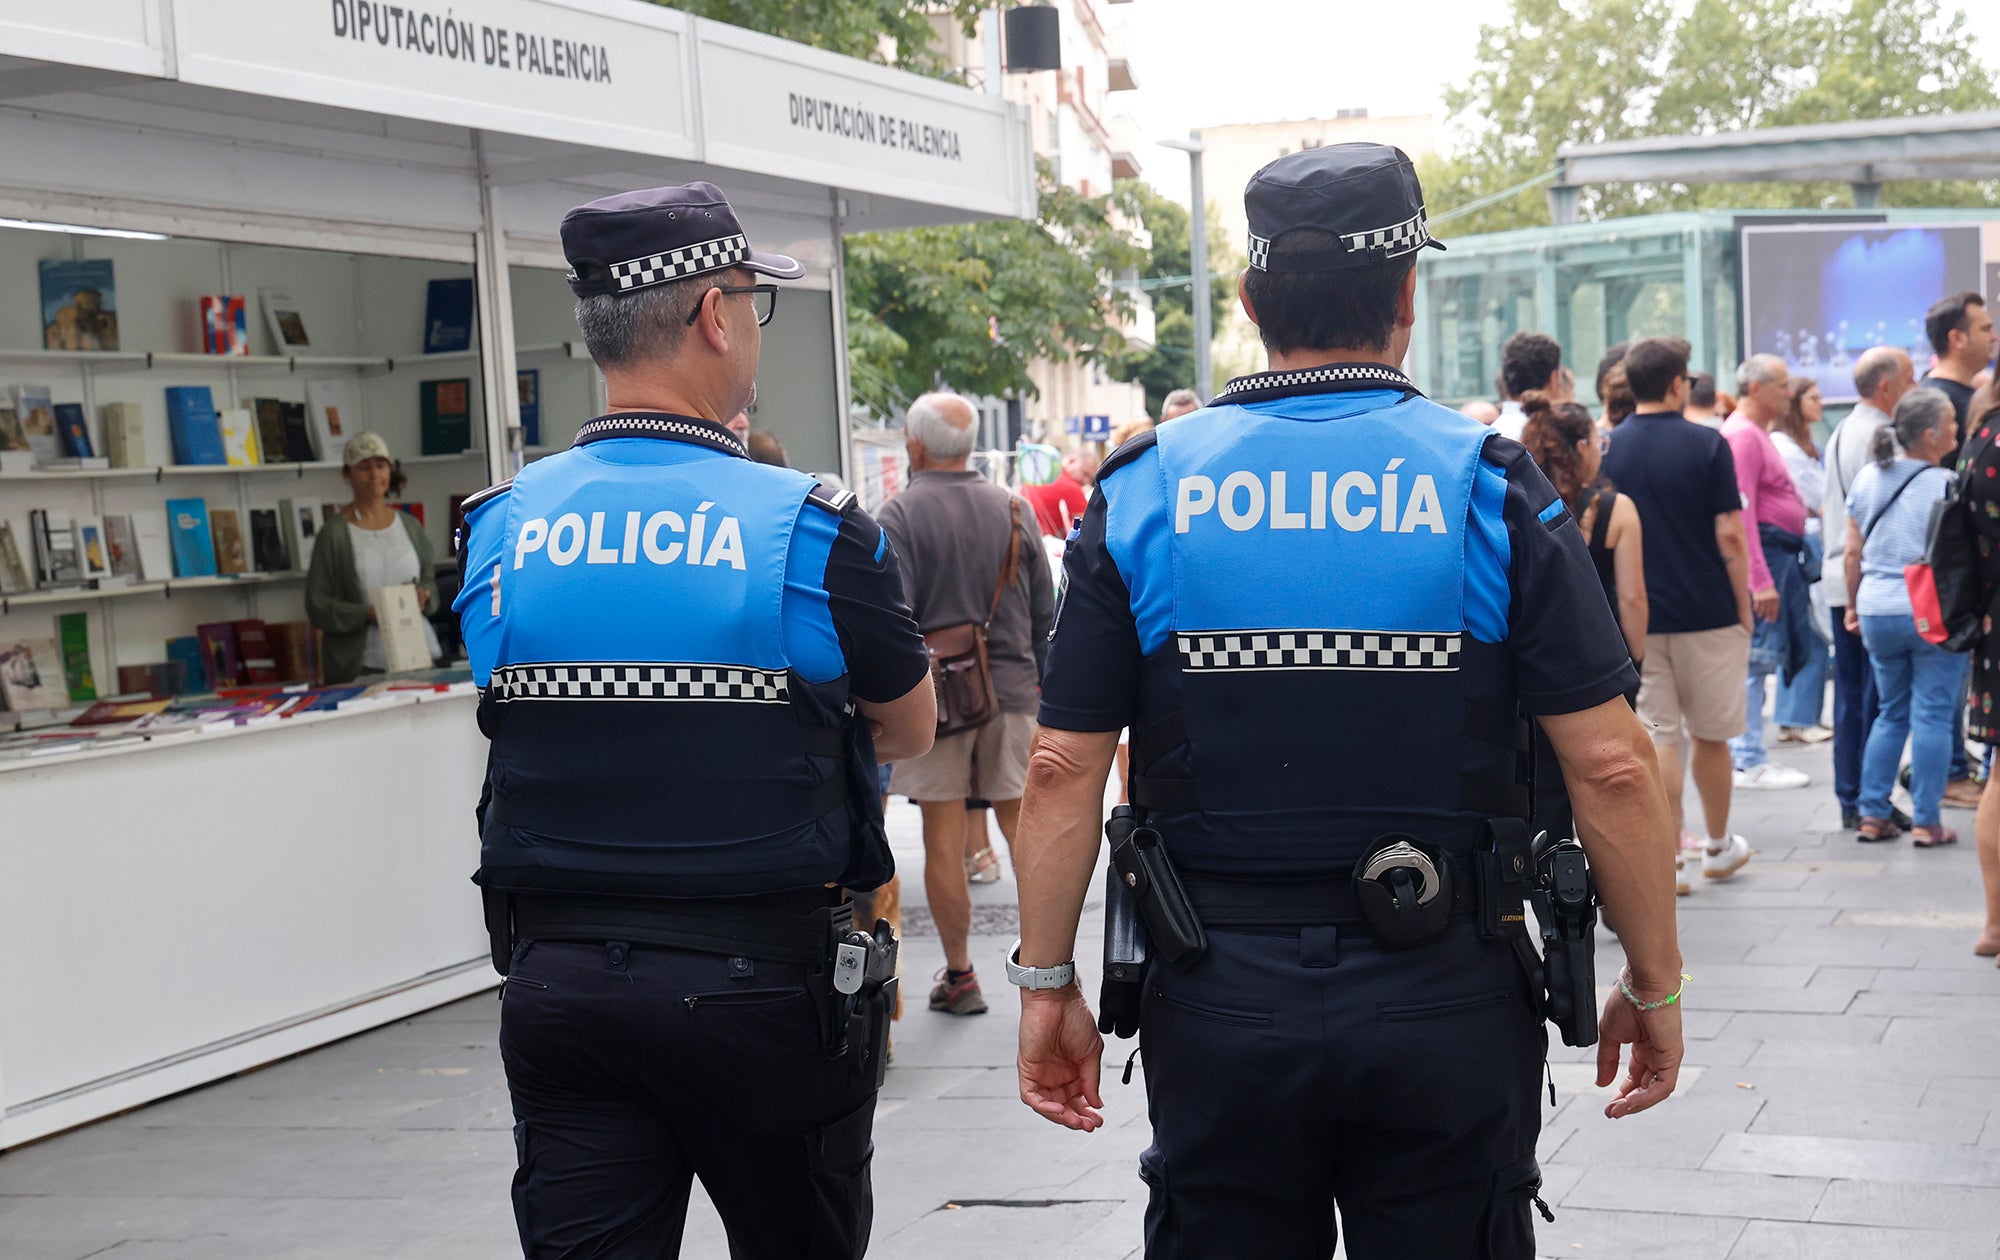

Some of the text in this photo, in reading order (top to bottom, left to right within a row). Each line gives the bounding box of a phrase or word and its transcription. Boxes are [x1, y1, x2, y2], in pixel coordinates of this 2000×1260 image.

[332, 0, 612, 84] DIPUTACIÓN DE PALENCIA
[789, 93, 961, 160] DIPUTACIÓN DE PALENCIA
[1175, 457, 1448, 534] POLICÍA
[513, 501, 746, 570] POLICÍA
